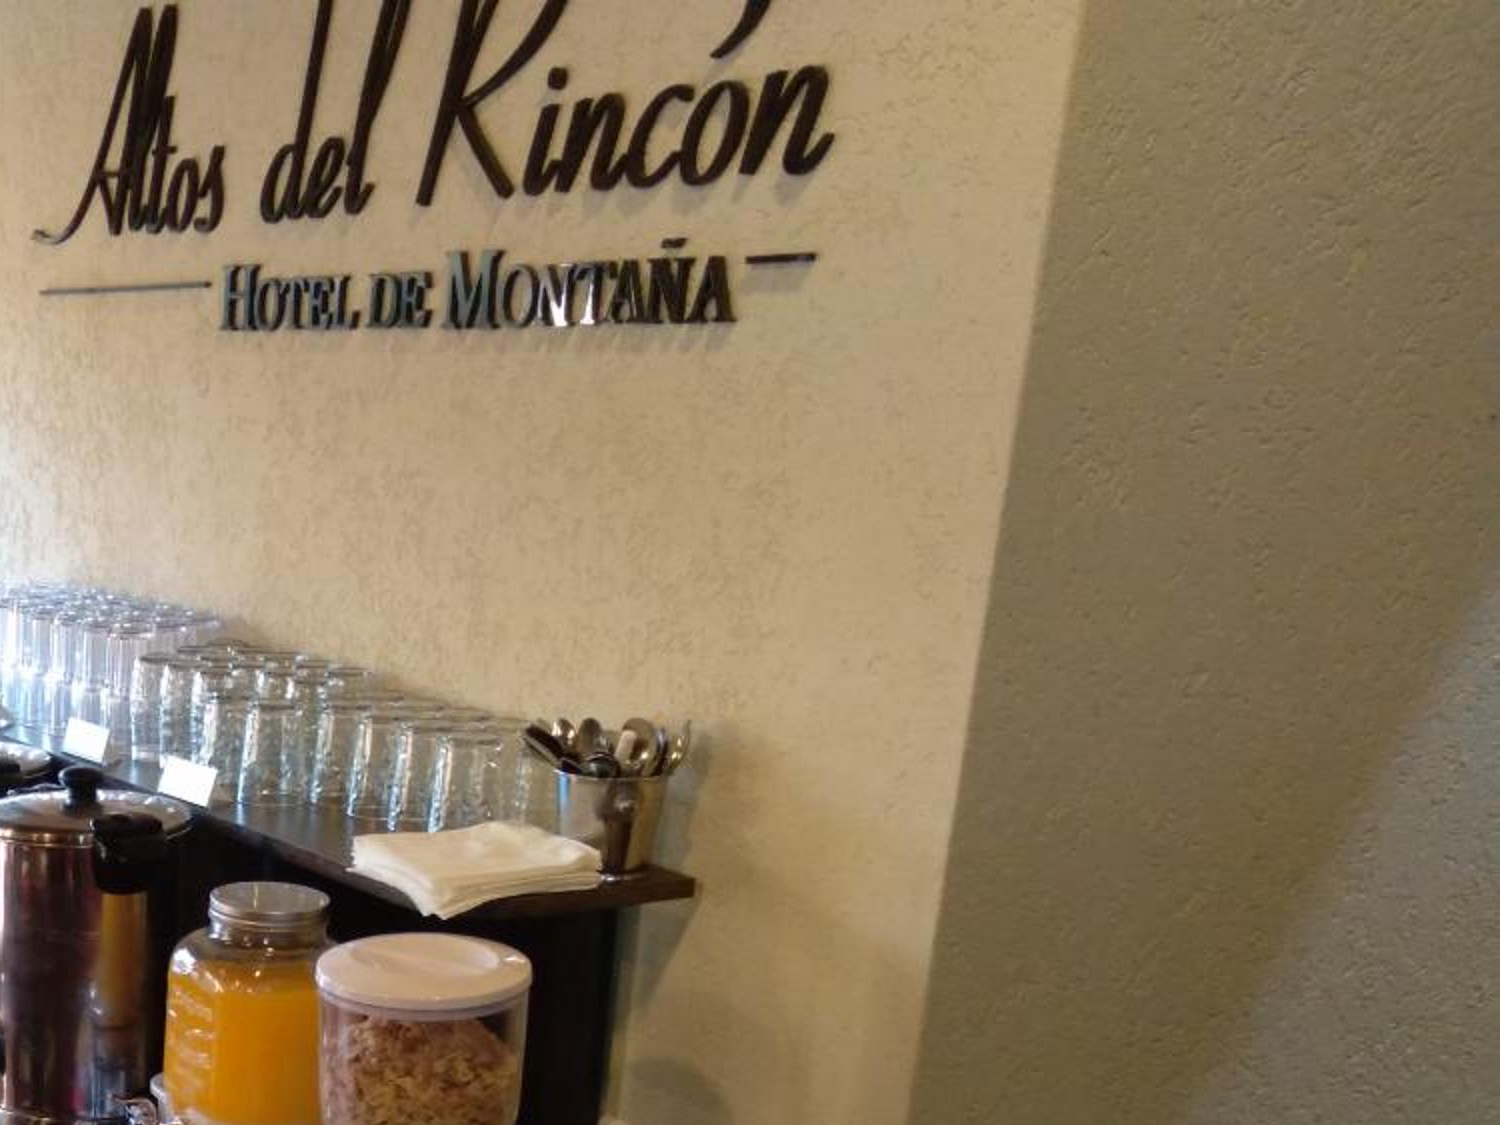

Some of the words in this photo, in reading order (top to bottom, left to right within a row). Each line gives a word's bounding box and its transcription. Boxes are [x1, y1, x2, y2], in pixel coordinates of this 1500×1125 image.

[32, 3, 227, 244] Altos
[260, 0, 410, 225] del
[414, 0, 836, 207] Rincón
[219, 262, 360, 331] HOTEL
[366, 270, 434, 329] DE
[441, 237, 737, 330] MONTAÑA
